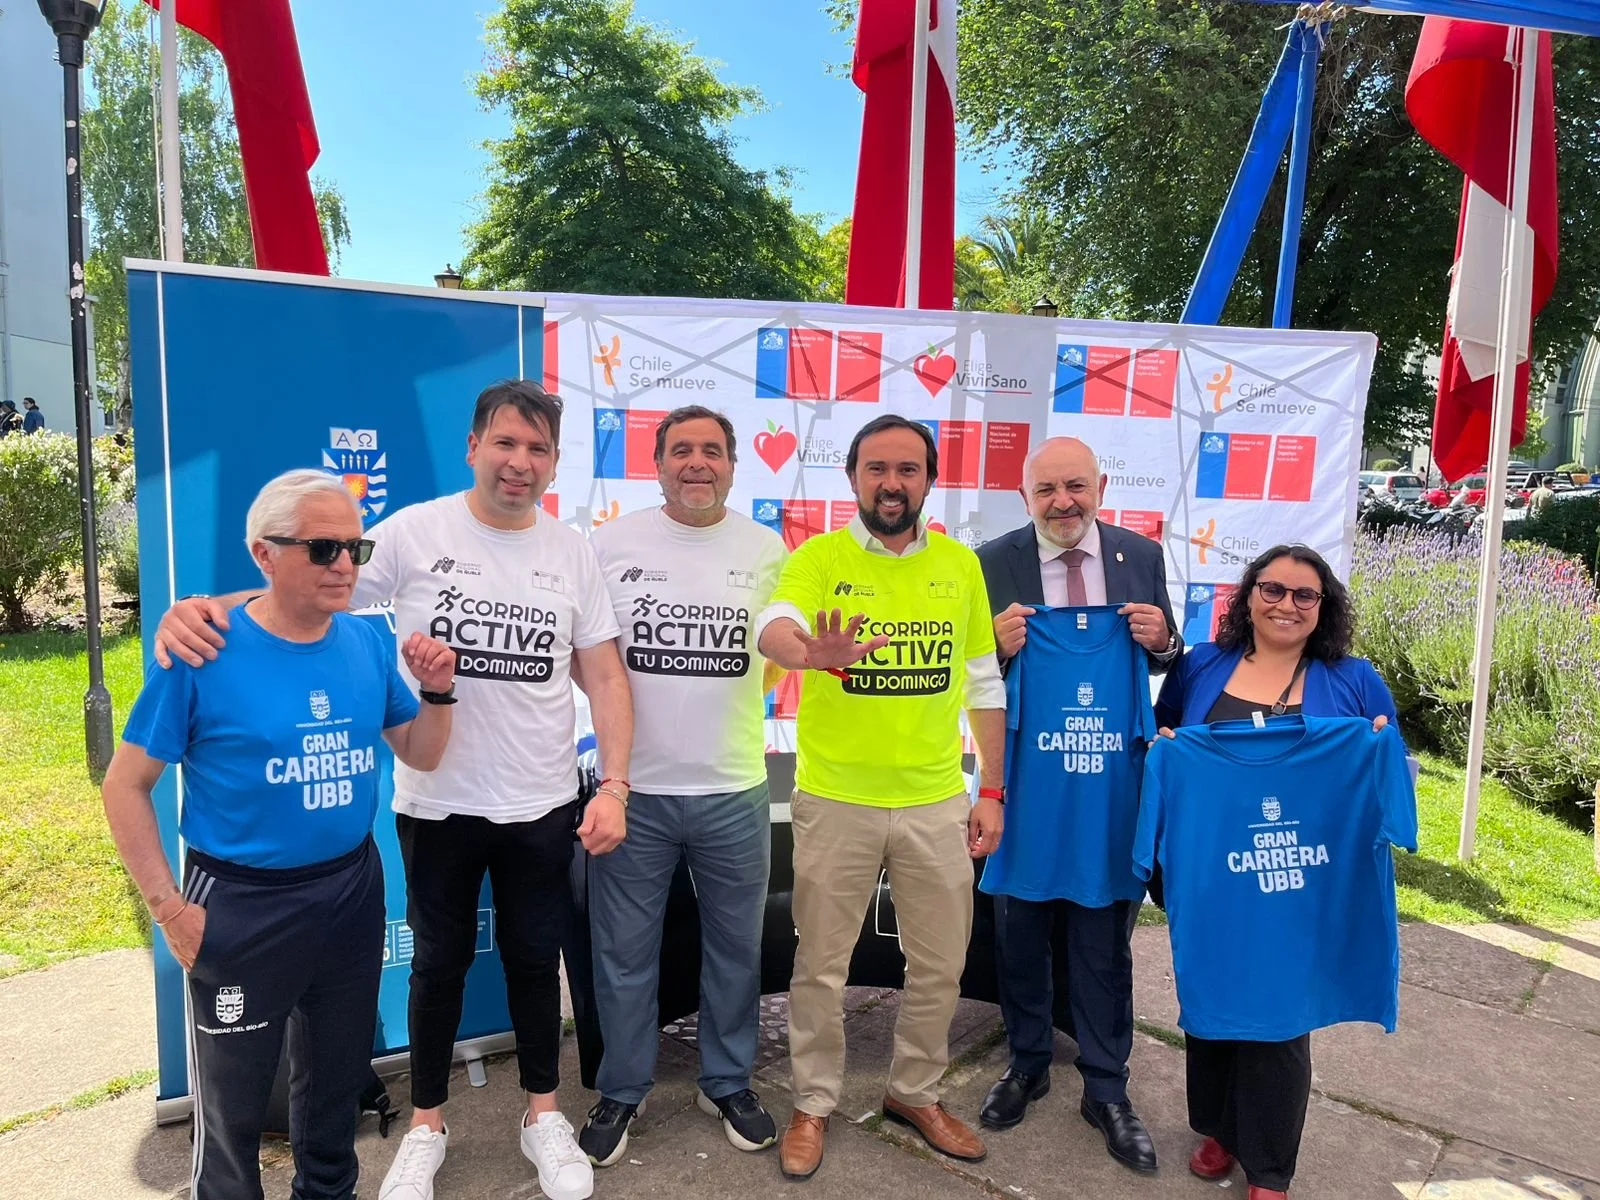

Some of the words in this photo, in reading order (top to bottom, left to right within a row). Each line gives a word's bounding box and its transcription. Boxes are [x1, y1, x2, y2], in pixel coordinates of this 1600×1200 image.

[628, 355, 672, 371] Chile
[963, 360, 992, 376] Elige
[629, 373, 651, 387] Se
[656, 377, 716, 390] mueve
[956, 373, 1027, 389] VivirSano
[1238, 383, 1277, 398] Chile
[1235, 399, 1256, 413] Se
[1260, 403, 1317, 415] mueve
[804, 437, 833, 449] Elige
[797, 449, 848, 463] VivirSa
[1096, 456, 1126, 470] hile
[1110, 475, 1166, 488] mueve
[953, 527, 982, 541] Elige
[1221, 536, 1259, 550] Chile
[1220, 552, 1239, 565] Se
[461, 598, 557, 627] CORRIDA
[656, 603, 749, 622] CORRIDA
[430, 616, 555, 653] ACTIVA
[633, 620, 747, 649] ACTIVA
[870, 621, 953, 637] CORRIDA
[855, 640, 953, 666] CTIVA
[460, 655, 547, 676] DOMINGO
[633, 653, 655, 668] TU
[661, 655, 743, 672] DOMINGO
[849, 674, 871, 688] TU
[876, 673, 947, 690] DOMINGO
[1065, 716, 1104, 731] GRAN
[302, 730, 349, 754] GRAN
[1037, 731, 1123, 751] CARRERA
[265, 746, 374, 784] CARRERA
[1063, 753, 1104, 774] UBB
[303, 779, 353, 810] UBB
[1253, 830, 1298, 848] GRAN
[1227, 844, 1330, 873] CARRERA
[1257, 868, 1305, 893] UBB
